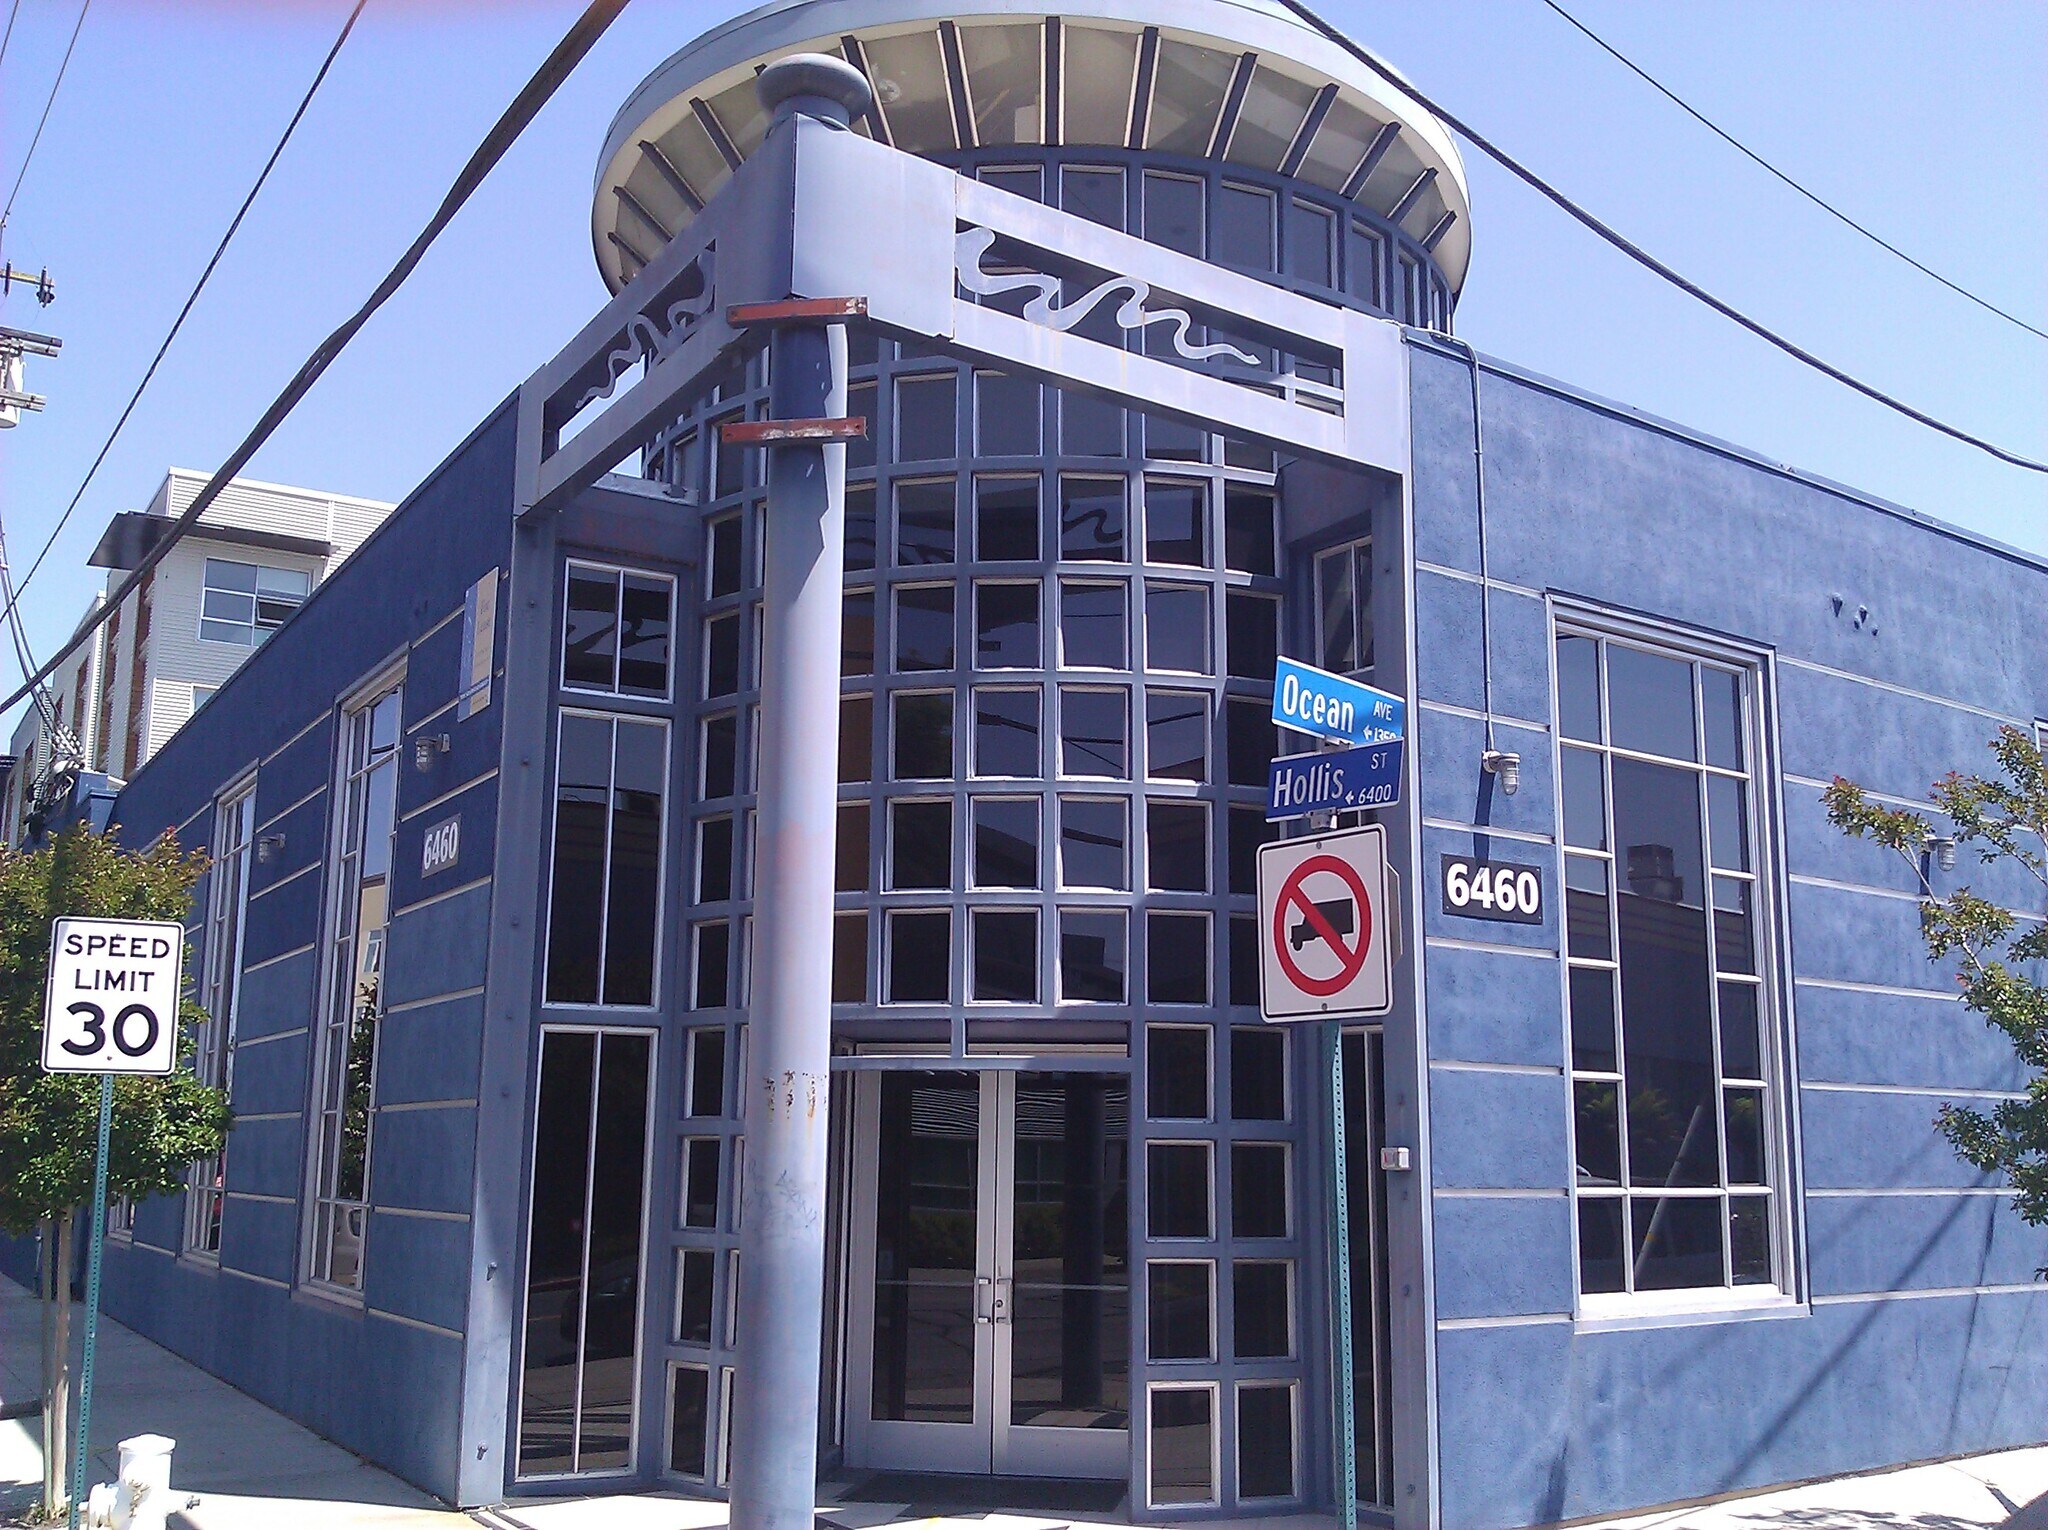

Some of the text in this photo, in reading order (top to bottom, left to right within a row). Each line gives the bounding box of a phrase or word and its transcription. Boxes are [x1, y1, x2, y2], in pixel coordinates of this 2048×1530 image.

[1282, 674, 1394, 733] Ocean AVE
[1273, 752, 1388, 808] Hollis ST
[1358, 784, 1392, 804] 6400
[423, 822, 459, 870] 6460
[1446, 862, 1540, 915] 6460
[65, 933, 170, 959] SPEED
[75, 968, 155, 992] LIMIT
[60, 1001, 160, 1057] 30
